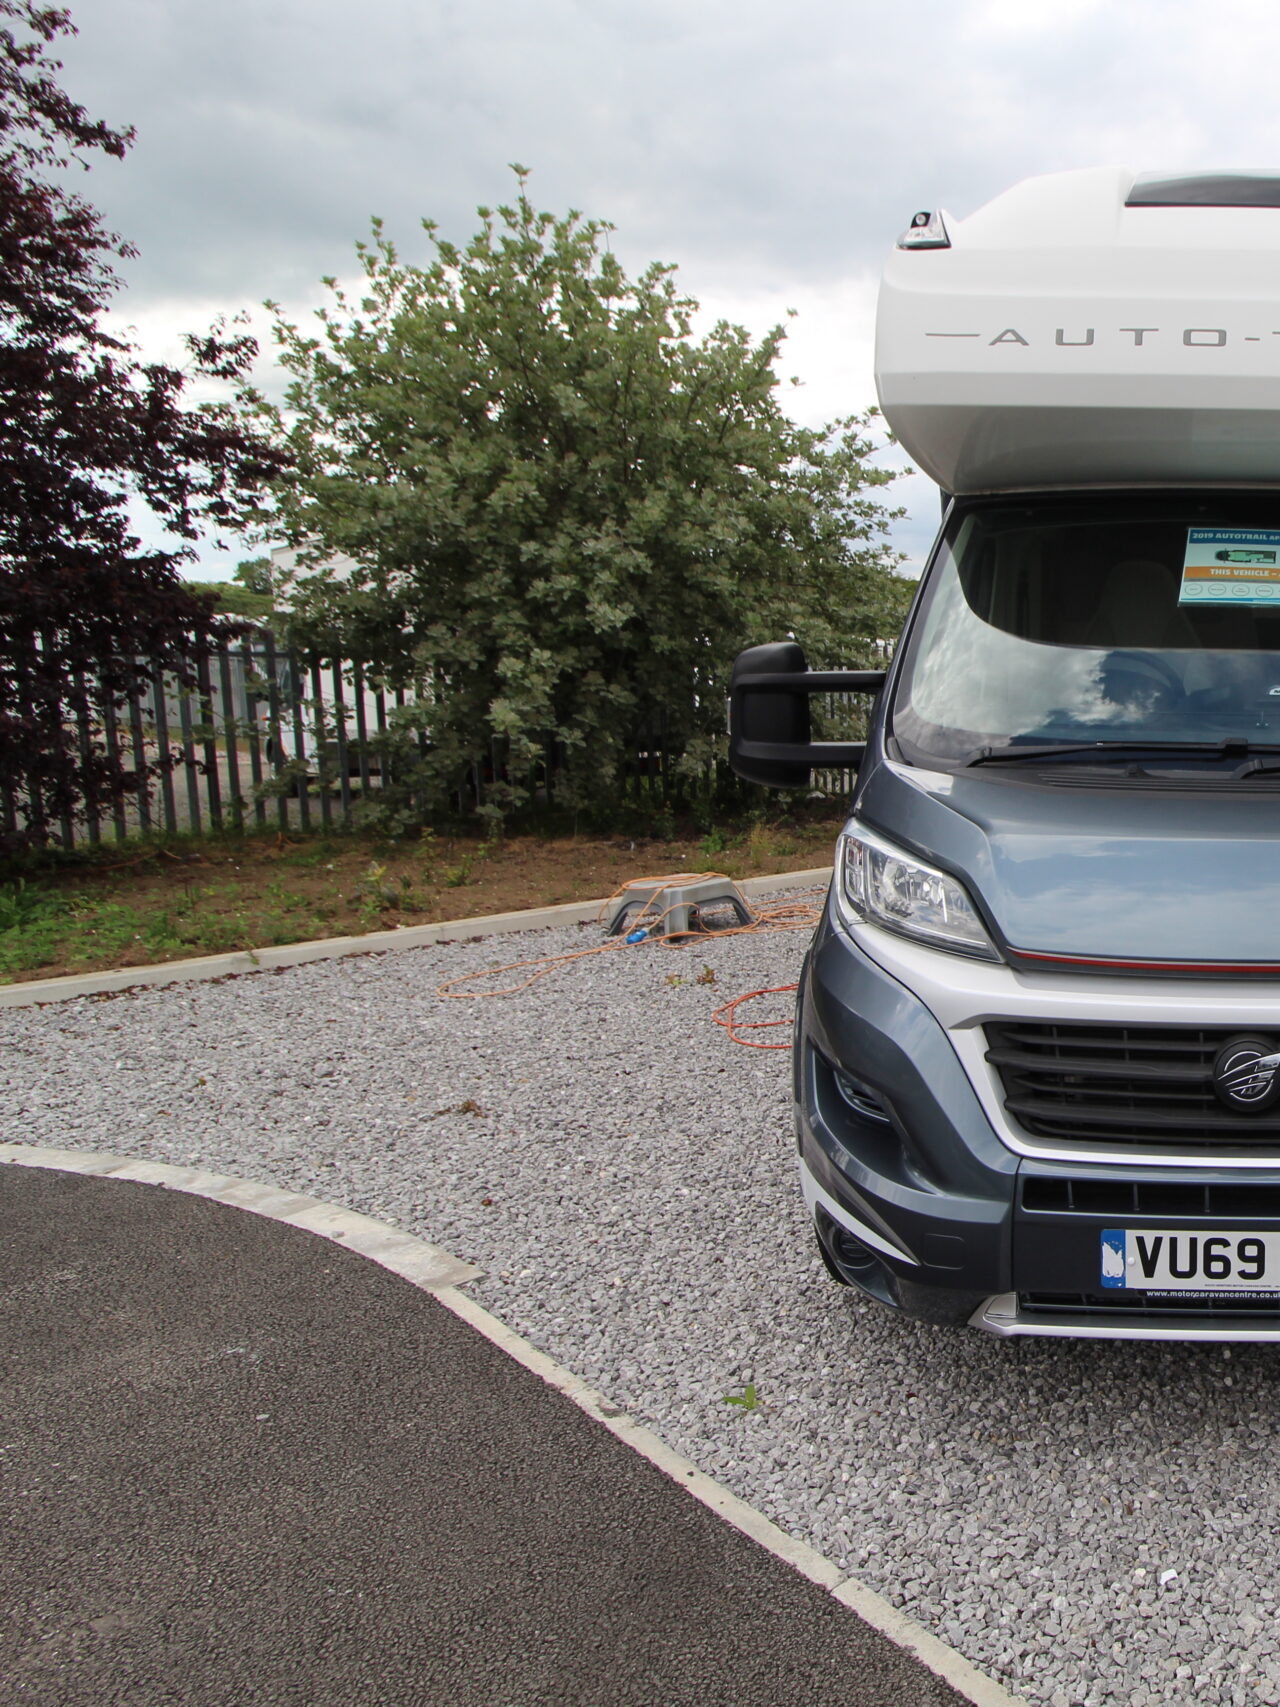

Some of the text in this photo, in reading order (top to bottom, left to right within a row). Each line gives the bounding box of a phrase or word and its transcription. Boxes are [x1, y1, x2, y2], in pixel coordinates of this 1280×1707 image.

[1215, 532, 1268, 541] AUTOTRAIL
[1209, 568, 1231, 576] THIS
[1233, 568, 1270, 578] VEHICLE
[1135, 1235, 1266, 1281] VU69
